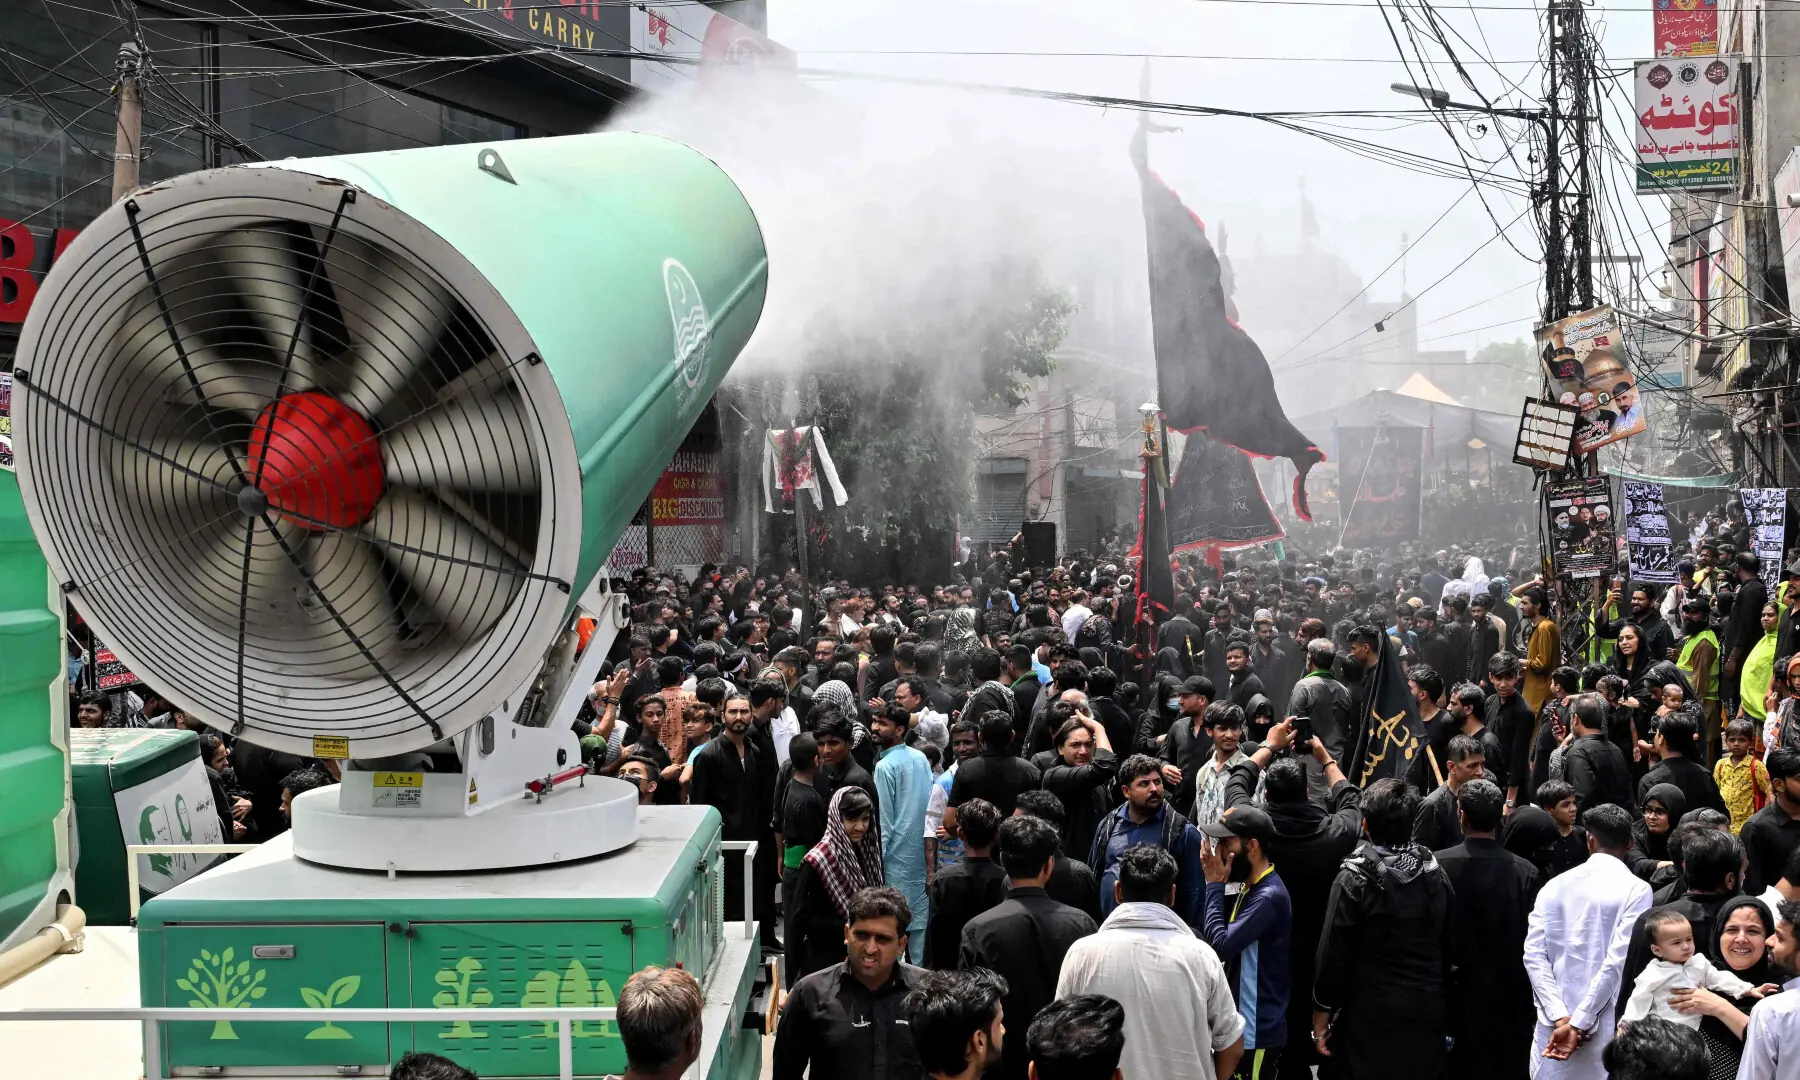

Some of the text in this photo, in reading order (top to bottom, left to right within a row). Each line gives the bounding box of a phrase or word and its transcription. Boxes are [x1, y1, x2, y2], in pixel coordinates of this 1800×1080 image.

[528, 8, 595, 49] CARRY
[1640, 92, 1738, 136] کوئٹہ
[1669, 139, 1695, 155] چائے
[1711, 160, 1731, 175] 24
[652, 497, 724, 520] BIG DISCOUNT
